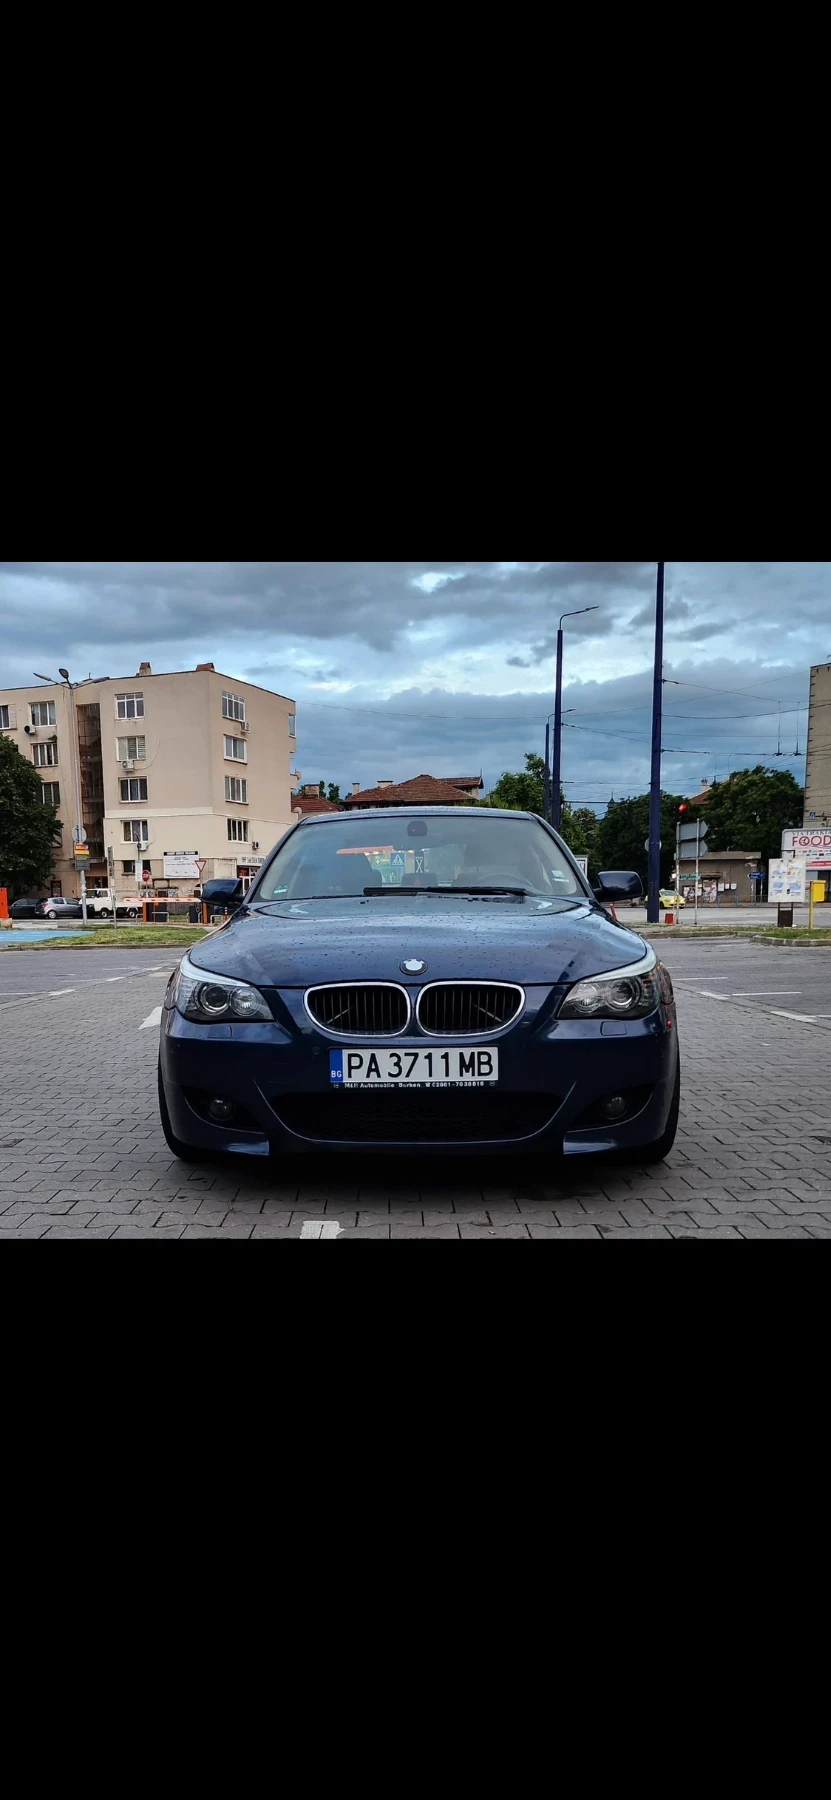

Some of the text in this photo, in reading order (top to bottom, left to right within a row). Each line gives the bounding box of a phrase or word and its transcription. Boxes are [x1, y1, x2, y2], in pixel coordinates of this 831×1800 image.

[792, 835, 831, 846] FOOD
[347, 1050, 494, 1079] PA 3711 MB
[331, 1070, 342, 1078] BG
